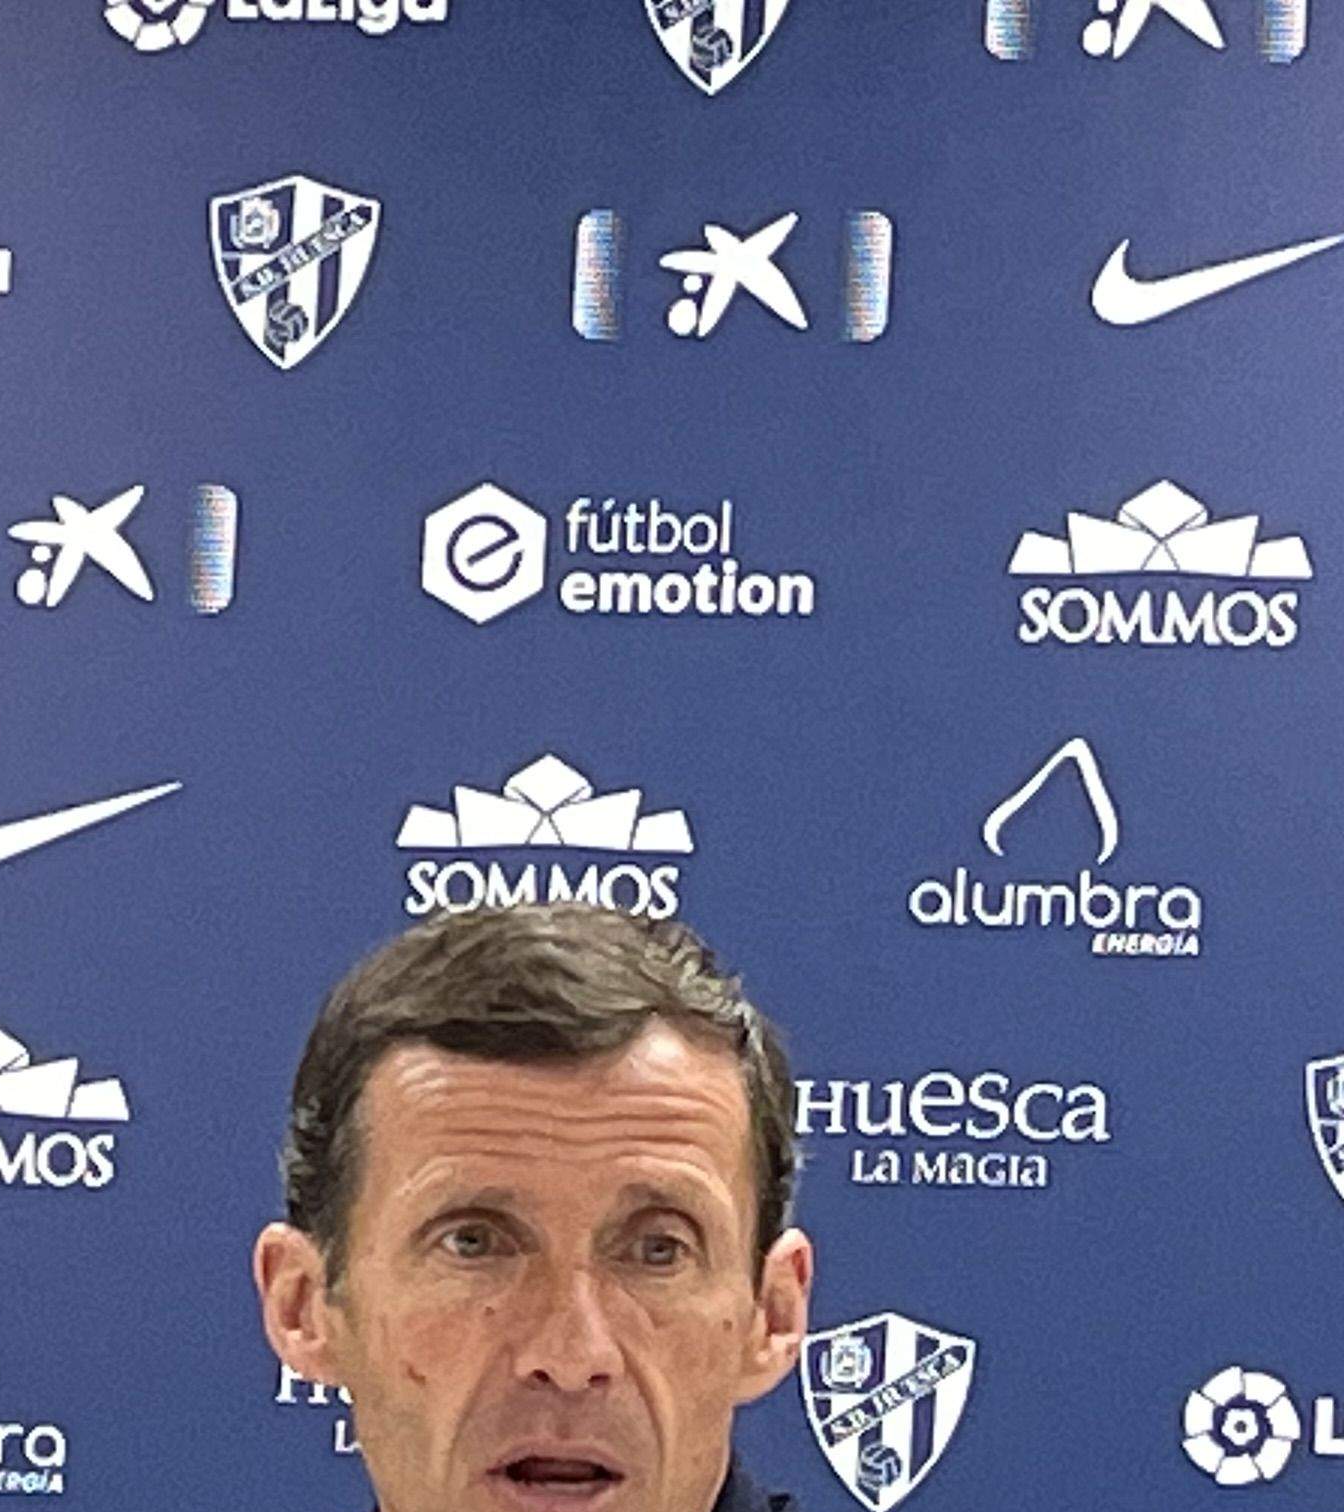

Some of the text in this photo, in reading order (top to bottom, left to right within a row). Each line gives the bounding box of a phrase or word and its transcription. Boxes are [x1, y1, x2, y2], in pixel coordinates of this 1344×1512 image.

[565, 497, 732, 554] fútbol
[560, 559, 814, 615] emotion
[1019, 587, 1298, 647] SOMMOS
[909, 867, 1201, 929] alumbra
